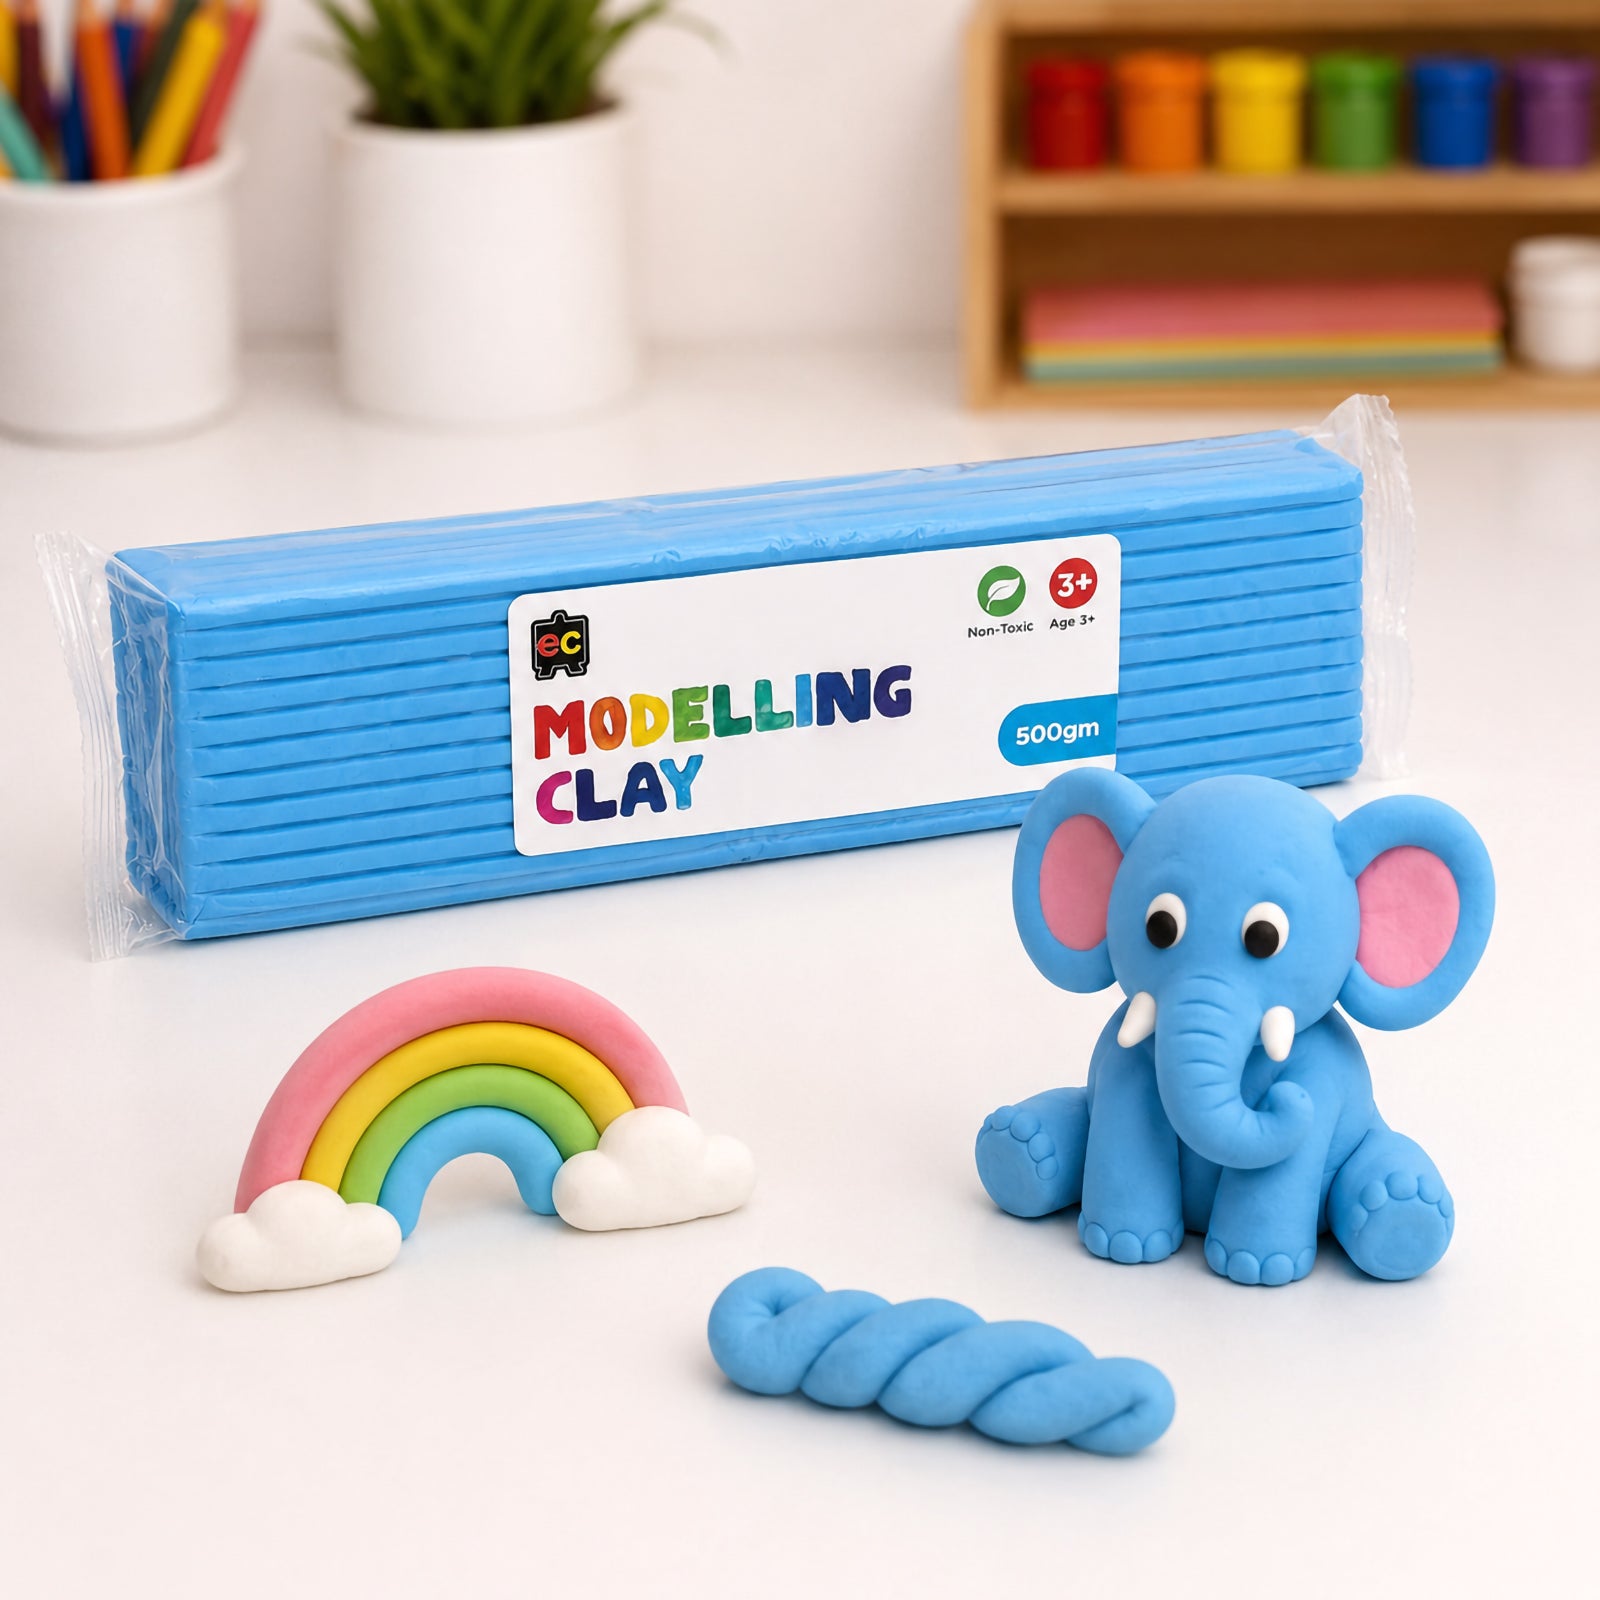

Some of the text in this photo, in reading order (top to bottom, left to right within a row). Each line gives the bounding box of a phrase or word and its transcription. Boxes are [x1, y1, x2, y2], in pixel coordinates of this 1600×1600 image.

[1057, 573, 1092, 597] 3+
[968, 621, 1034, 638] Non-Toxic
[1049, 614, 1096, 630] Age 3+
[536, 631, 581, 657] ec
[533, 665, 912, 760] MODELLING
[1016, 721, 1099, 746] 500gm
[535, 754, 704, 825] CLAY
